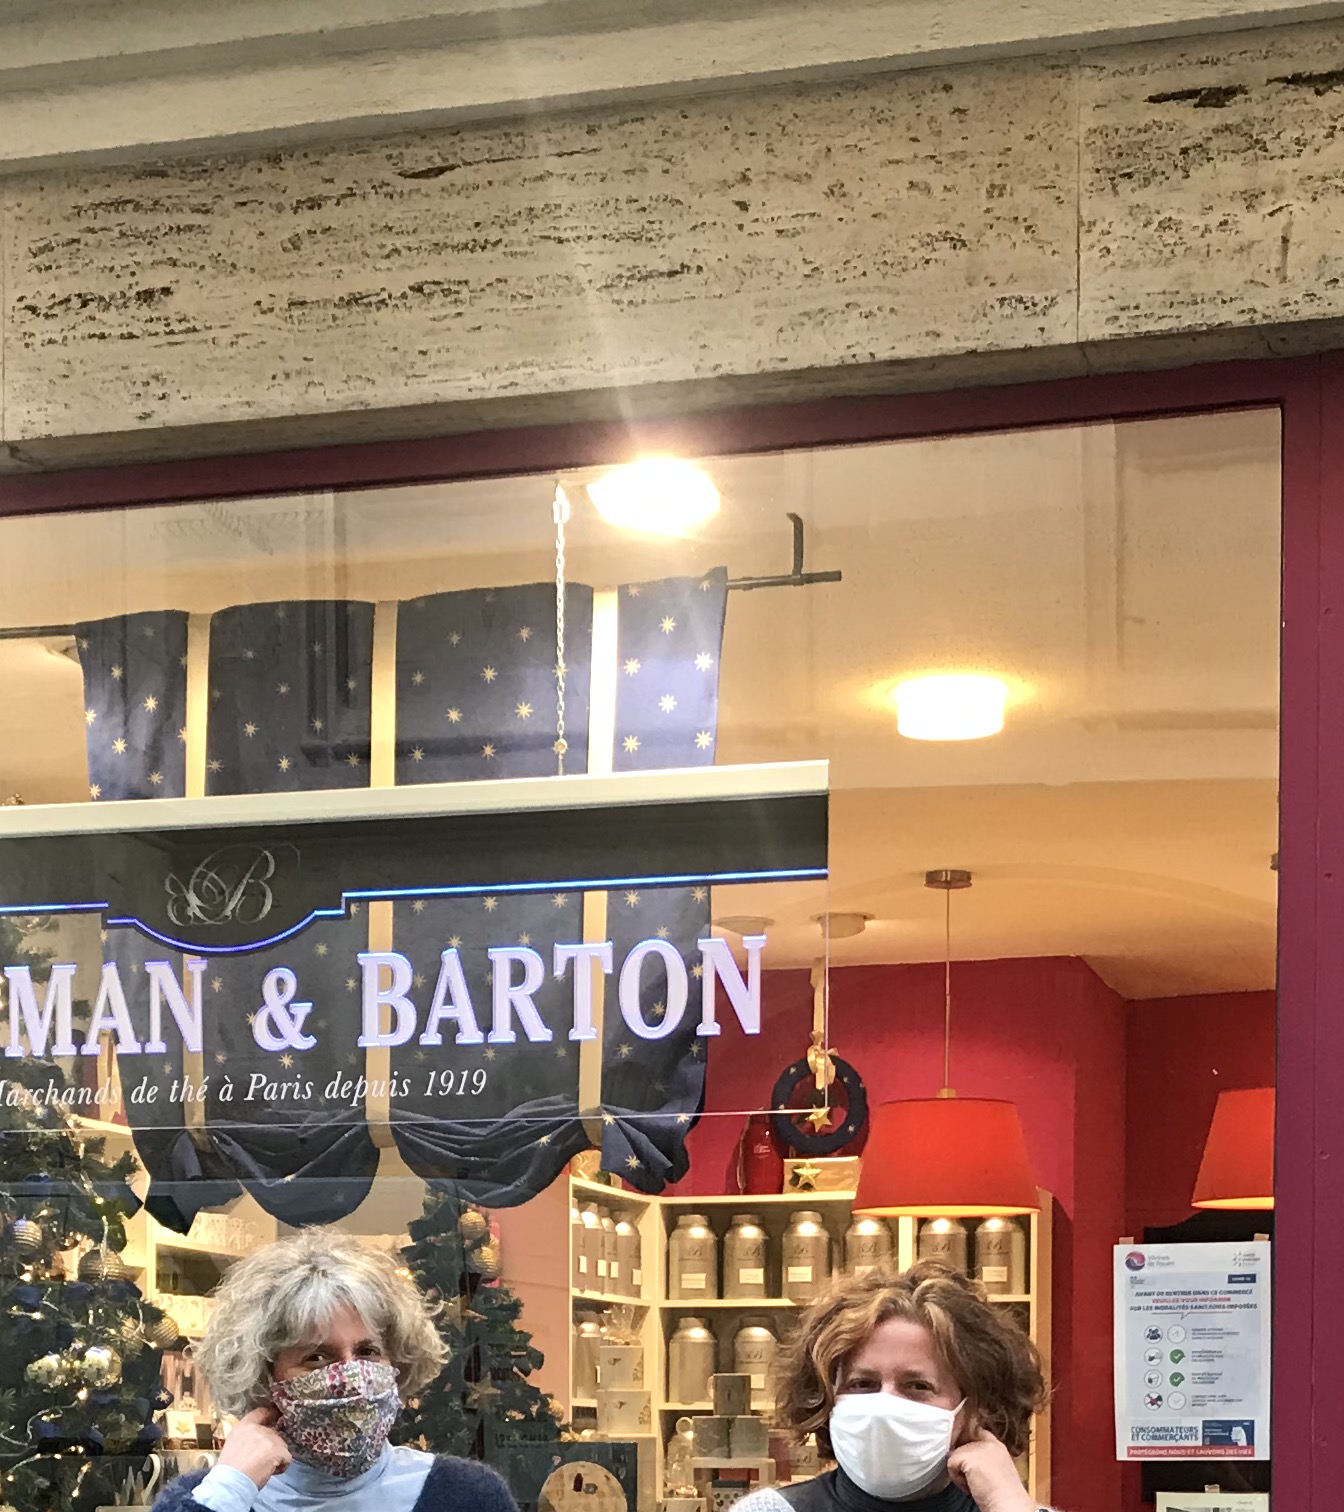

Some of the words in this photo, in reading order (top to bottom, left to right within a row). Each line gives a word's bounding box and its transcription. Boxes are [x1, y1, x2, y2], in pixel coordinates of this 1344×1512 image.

[252, 966, 317, 1052] &
[356, 935, 767, 1048] BARTON
[130, 1077, 158, 1104] de
[168, 1073, 210, 1104] thé
[219, 1071, 235, 1102] à
[243, 1071, 315, 1102] Paris
[325, 1069, 412, 1107] depuis
[422, 1067, 488, 1097] 1919
